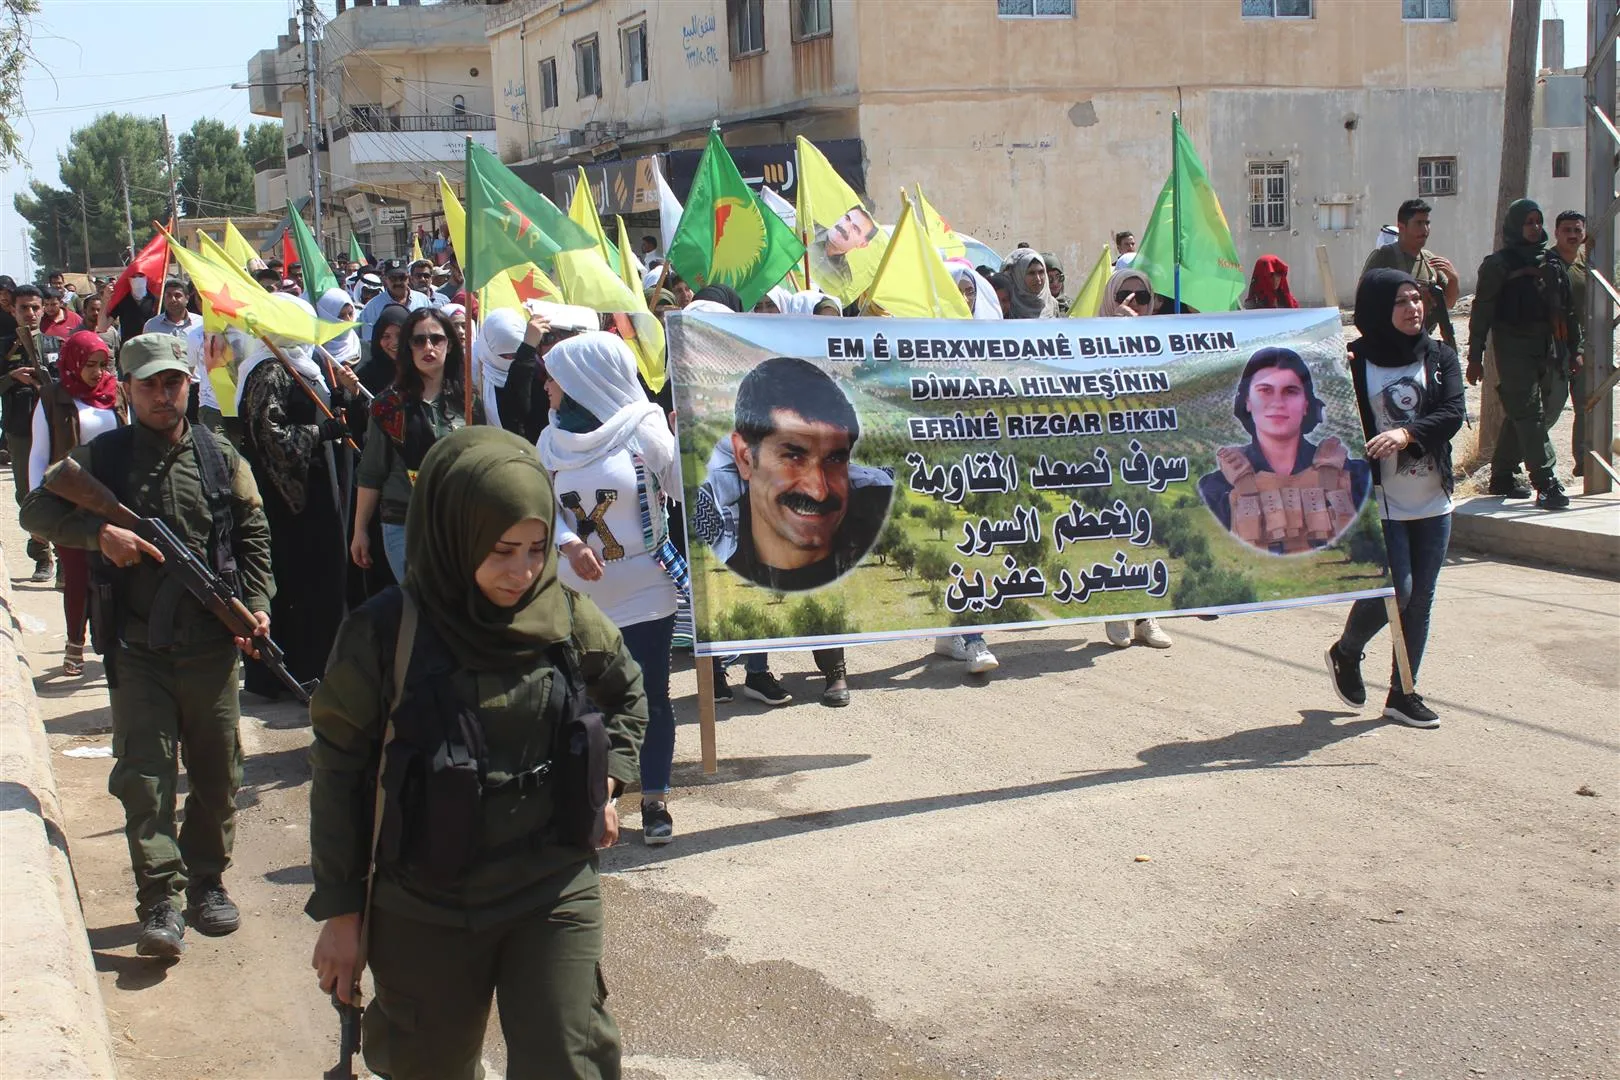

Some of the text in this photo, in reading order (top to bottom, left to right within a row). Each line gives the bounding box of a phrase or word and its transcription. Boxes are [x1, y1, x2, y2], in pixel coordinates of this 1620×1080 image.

[827, 337, 866, 361] EM
[872, 332, 891, 361] Ê
[897, 333, 1073, 360] BERXWEDANÊ
[911, 373, 1016, 399] DÎWARA
[909, 411, 1000, 440] EFRÎNÊ
[906, 440, 1187, 502] سوف نصعد المقاومة
[956, 500, 1151, 555] ونحطم السور
[946, 552, 1168, 612] وسنحرر عفرين
